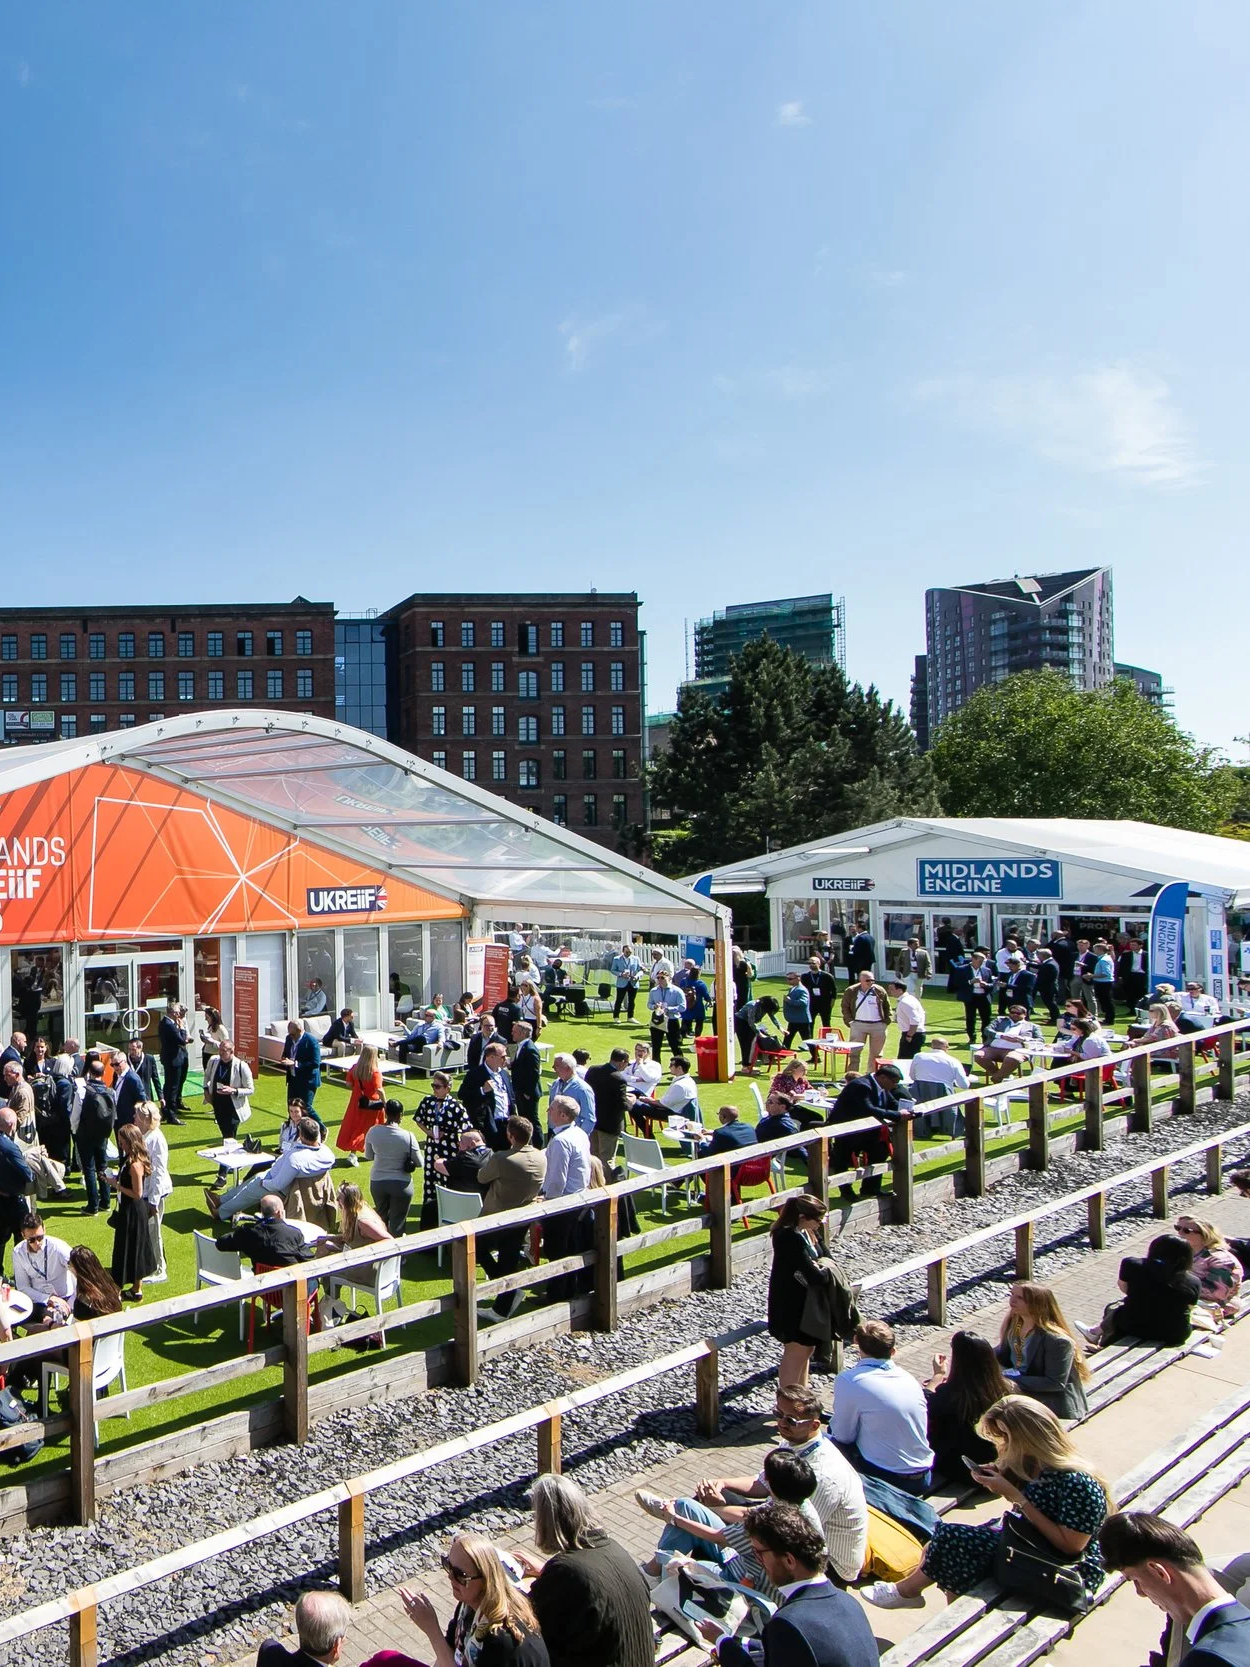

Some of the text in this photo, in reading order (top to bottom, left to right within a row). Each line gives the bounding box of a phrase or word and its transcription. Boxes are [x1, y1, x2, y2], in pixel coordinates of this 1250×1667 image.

[924, 863, 1053, 879] MIDLANDS
[814, 879, 866, 891] UKREiiF
[924, 879, 1002, 893] ENGINE
[309, 888, 376, 912] UKREiiF
[1158, 919, 1168, 953] ENGINE
[1166, 920, 1178, 975] MIDLANDS
